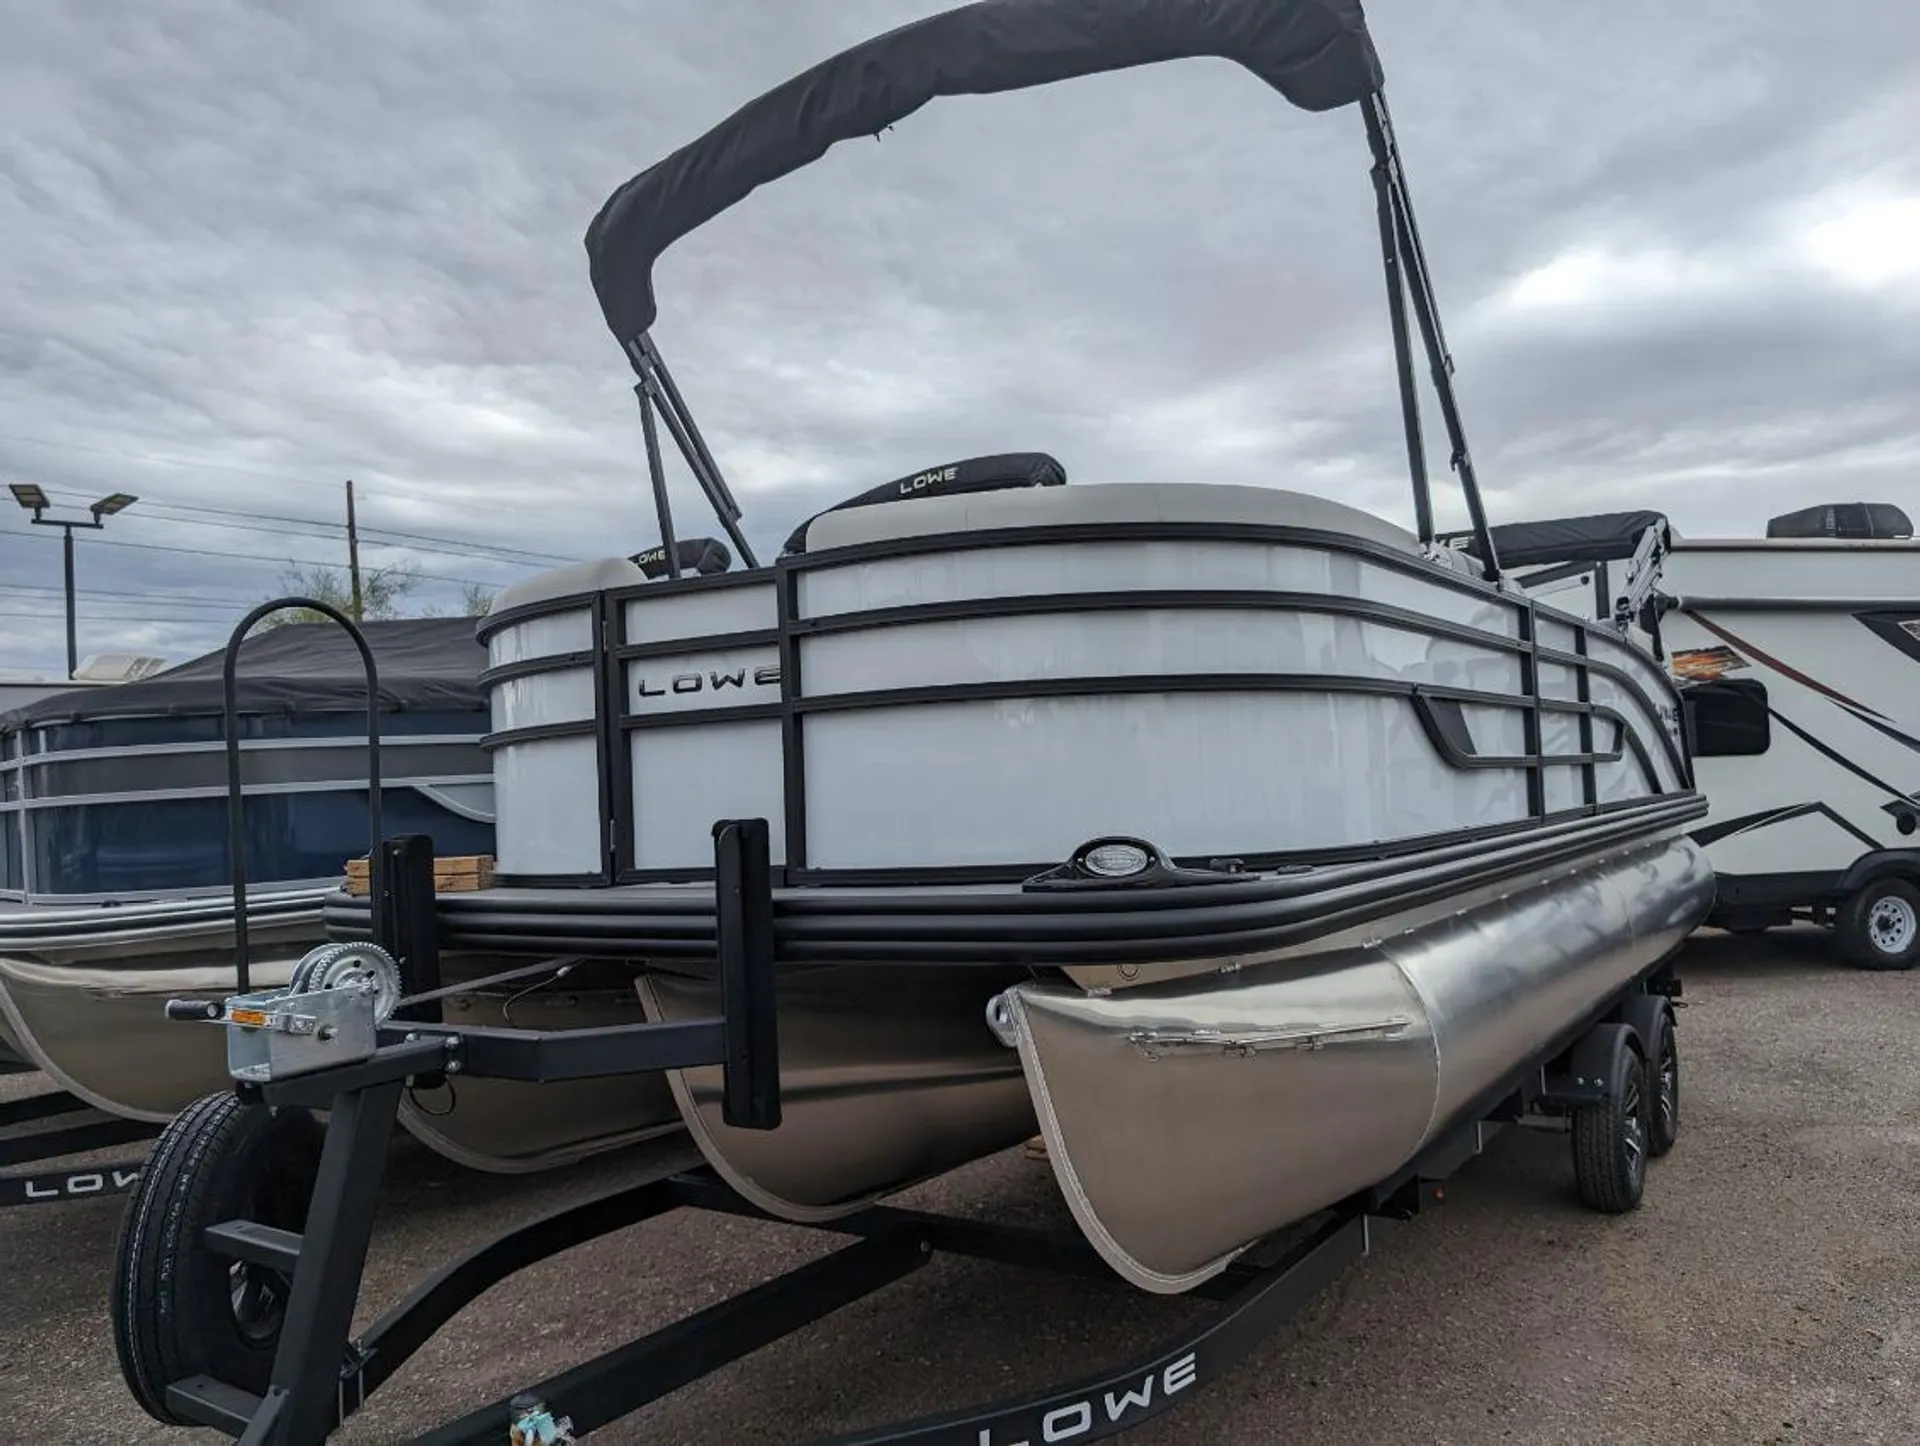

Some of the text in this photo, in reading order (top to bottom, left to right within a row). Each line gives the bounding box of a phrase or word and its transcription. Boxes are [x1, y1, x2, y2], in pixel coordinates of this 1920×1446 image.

[900, 466, 958, 494] LOWE
[638, 549, 666, 565] OWE
[638, 665, 781, 697] LOWE
